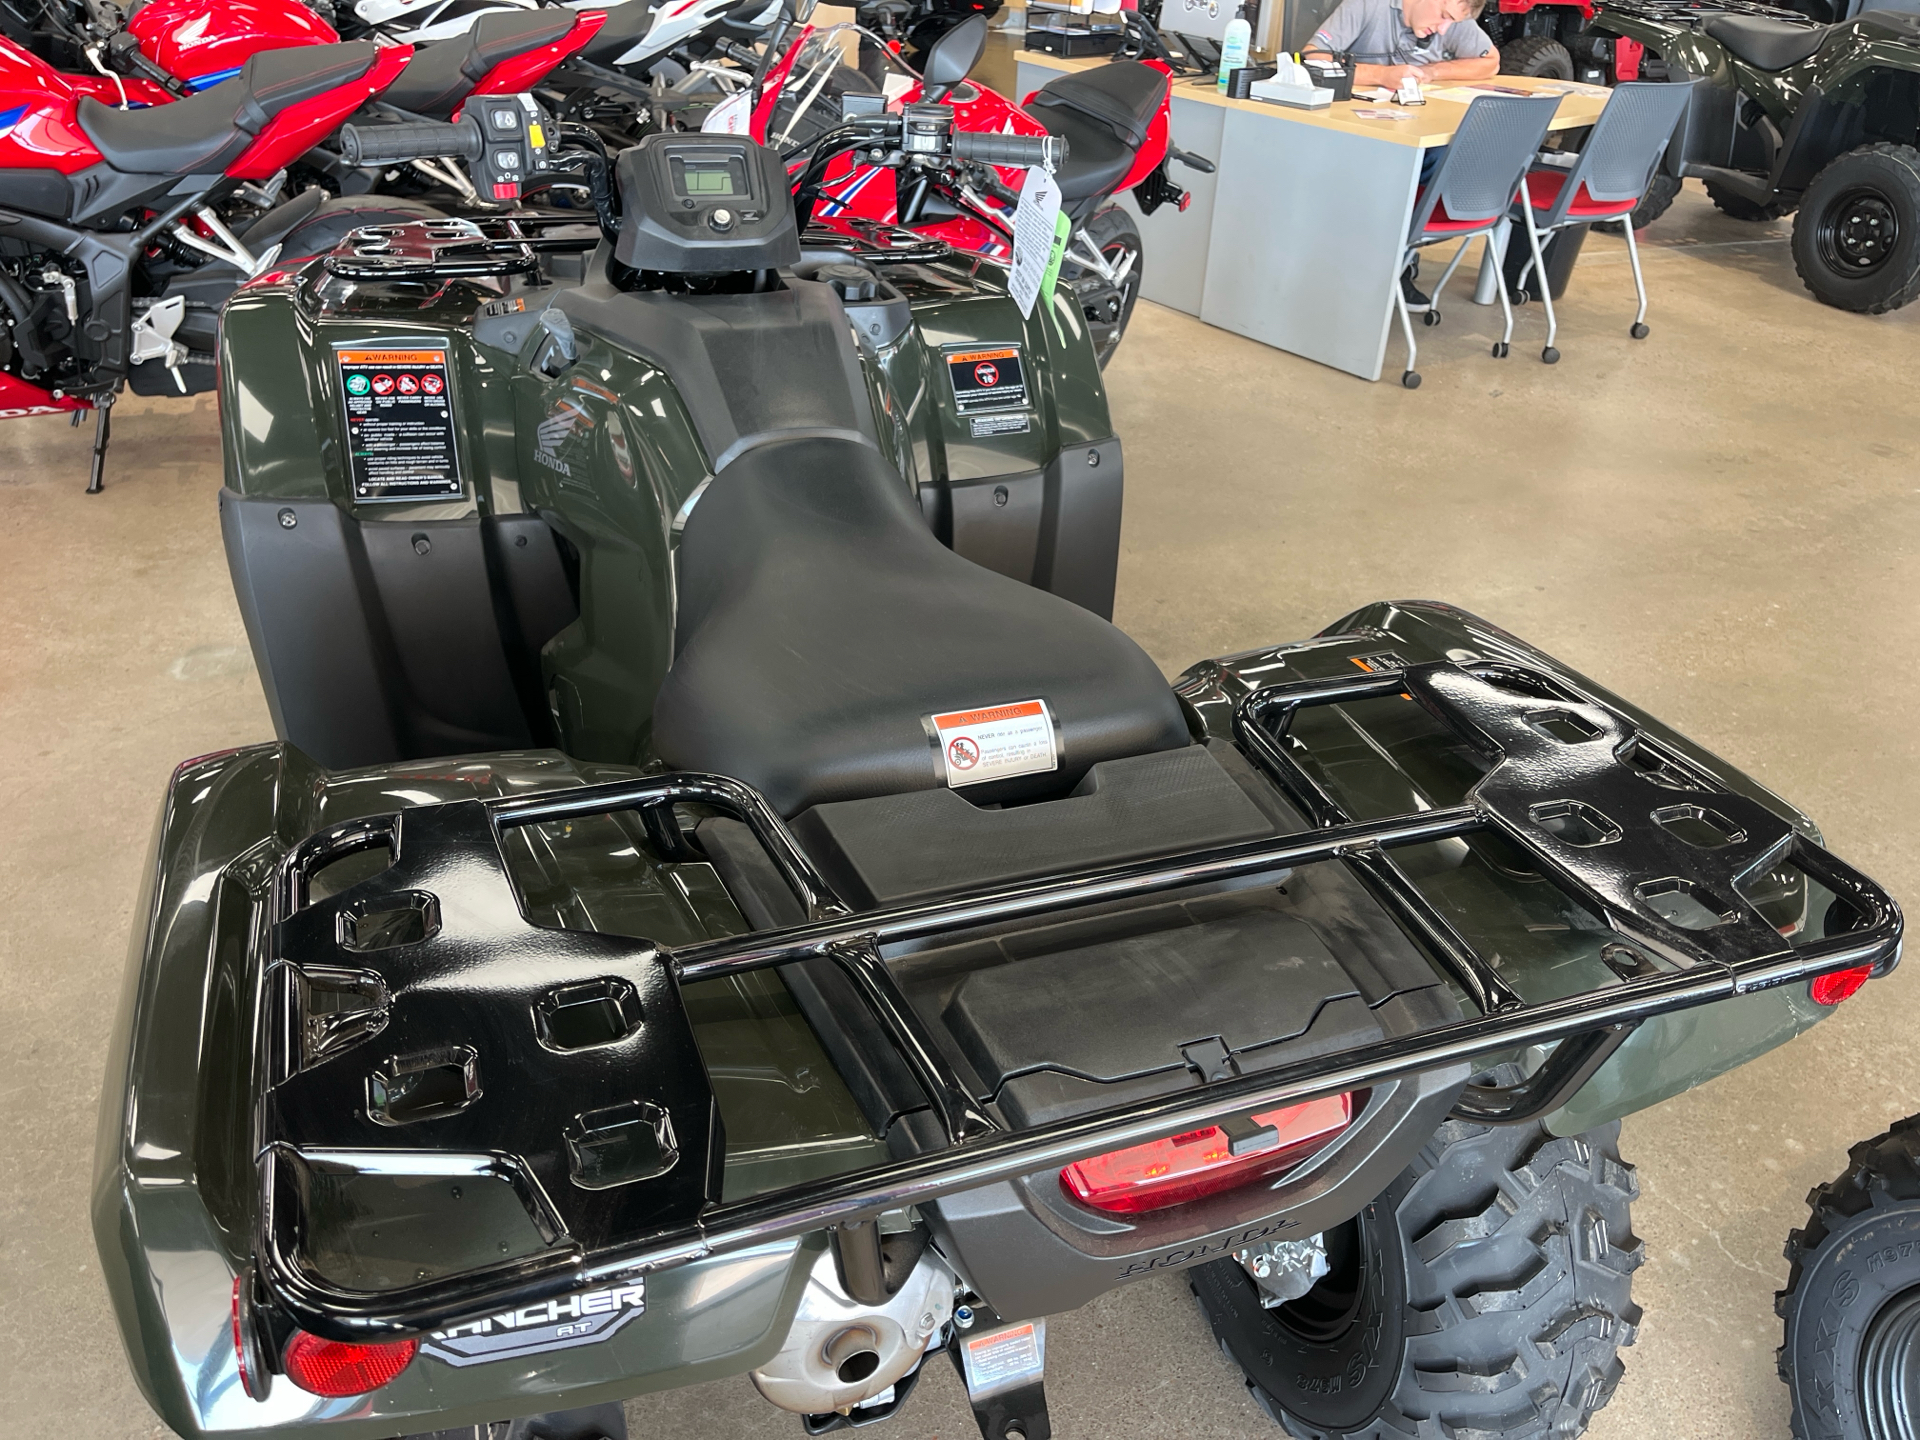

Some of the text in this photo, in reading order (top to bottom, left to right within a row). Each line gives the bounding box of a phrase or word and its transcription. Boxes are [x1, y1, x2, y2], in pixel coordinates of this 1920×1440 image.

[178, 34, 218, 52] HONDA
[970, 352, 1005, 360] WARNING
[533, 449, 571, 477] HONDA
[970, 707, 1022, 721] WARNING
[982, 760, 1003, 768] SEVERE
[1004, 756, 1022, 764] INJURY
[556, 1321, 592, 1337] AT
[986, 1329, 1023, 1344] WARNING
[1814, 1269, 1862, 1440] XXIS
